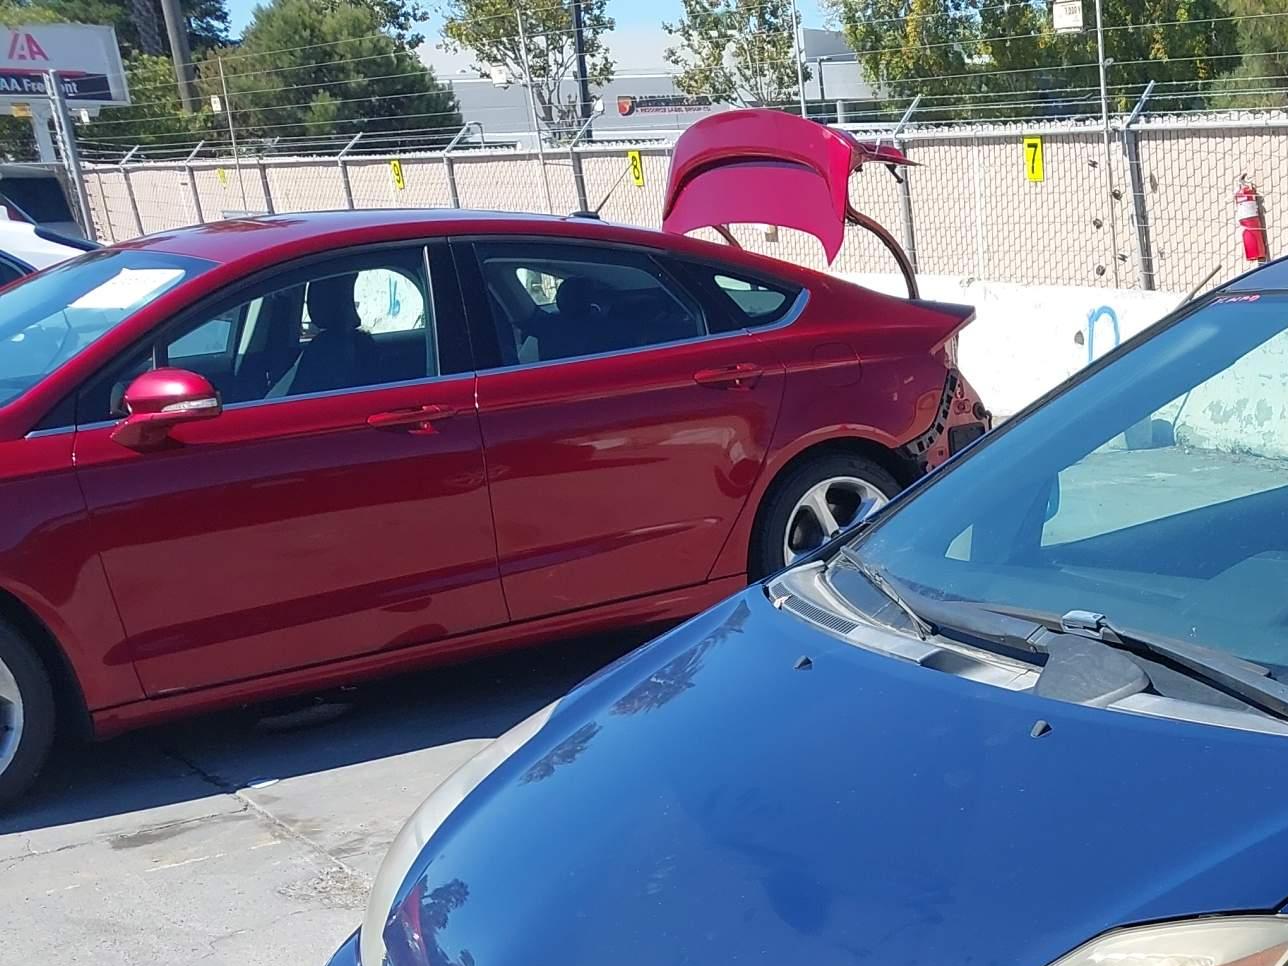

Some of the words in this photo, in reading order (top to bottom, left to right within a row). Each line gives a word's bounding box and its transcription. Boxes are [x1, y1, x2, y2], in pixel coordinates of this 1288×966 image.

[632, 156, 640, 180] 8
[1027, 143, 1038, 174] 7
[393, 163, 401, 184] 9
